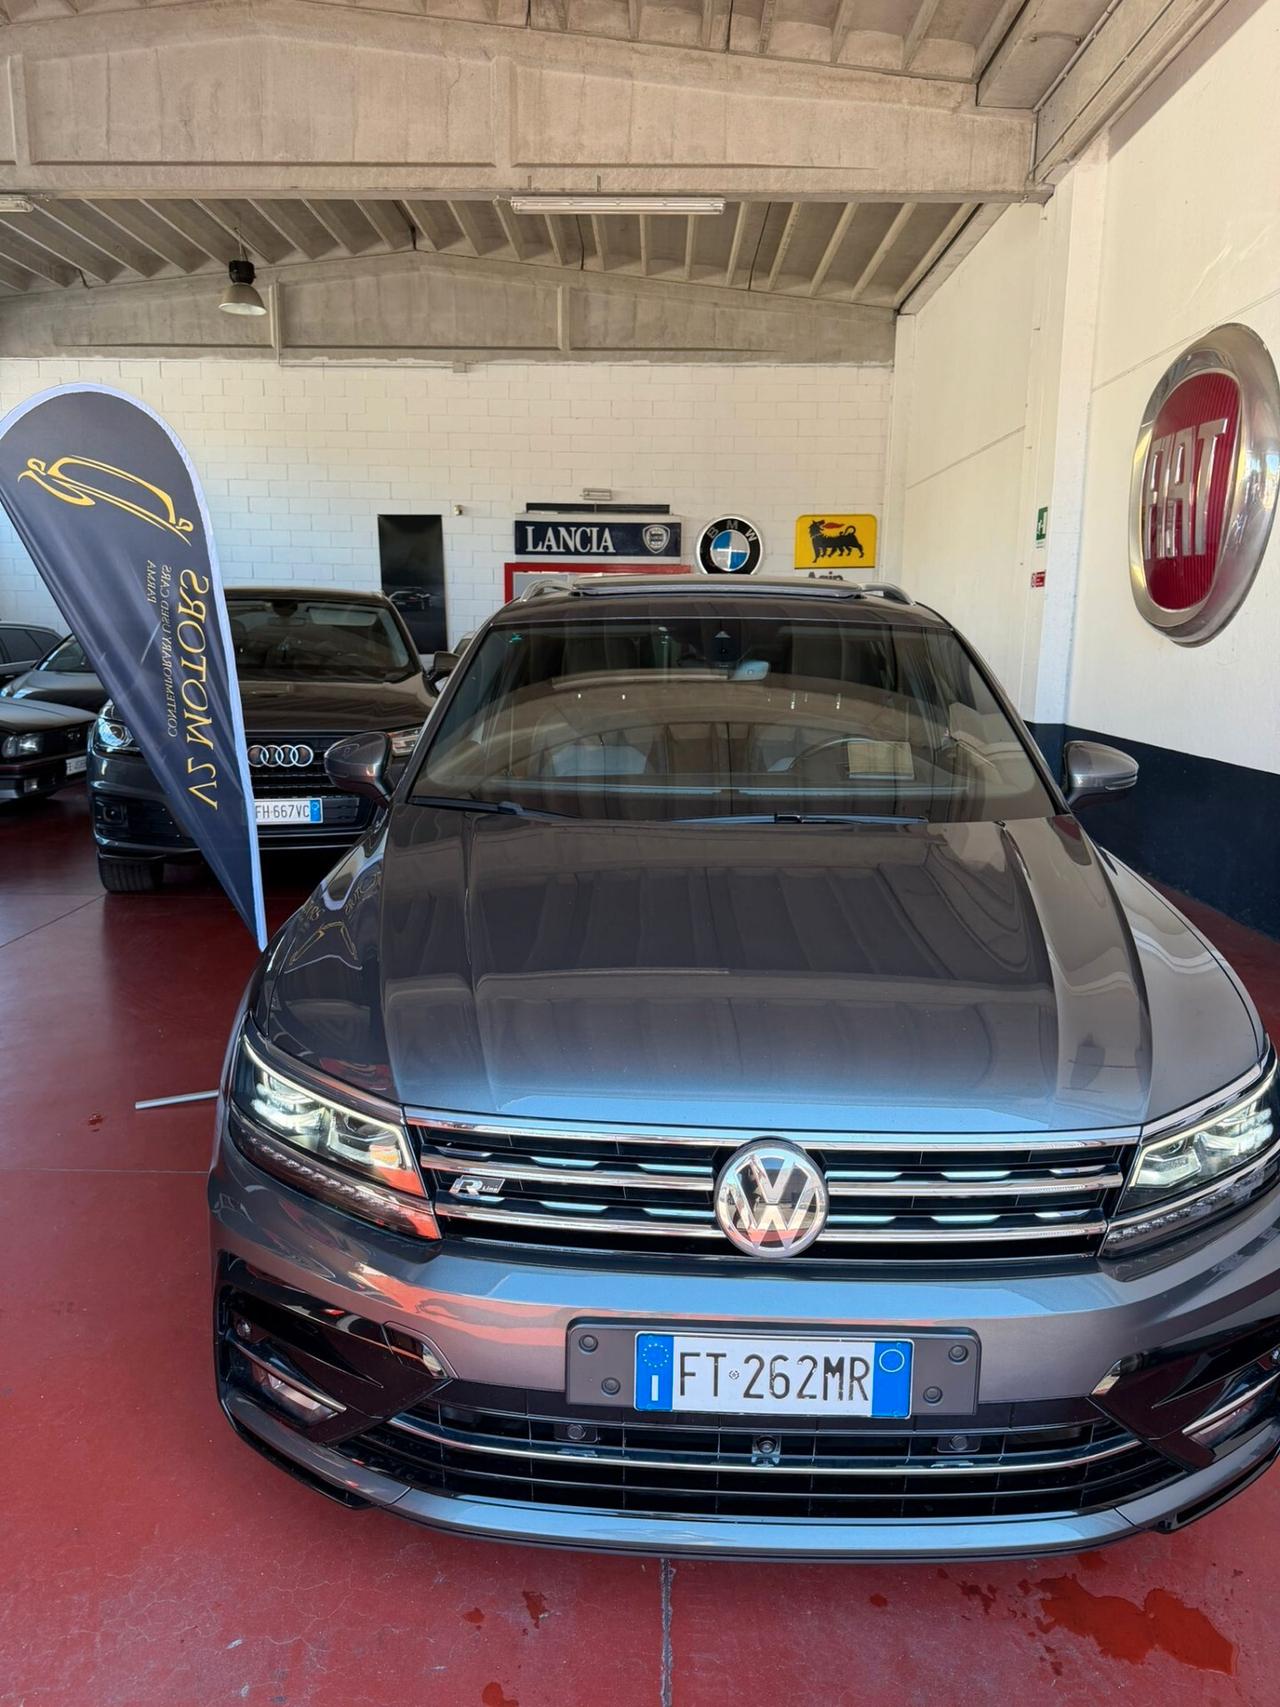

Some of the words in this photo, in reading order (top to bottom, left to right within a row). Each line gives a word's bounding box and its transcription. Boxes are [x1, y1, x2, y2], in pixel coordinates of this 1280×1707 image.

[1143, 418, 1228, 560] FIAT
[525, 526, 616, 553] LANCIA
[706, 519, 757, 543] BMW
[808, 571, 844, 581] Ai
[679, 1352, 727, 1397] FT
[743, 1353, 870, 1401] 262MR
